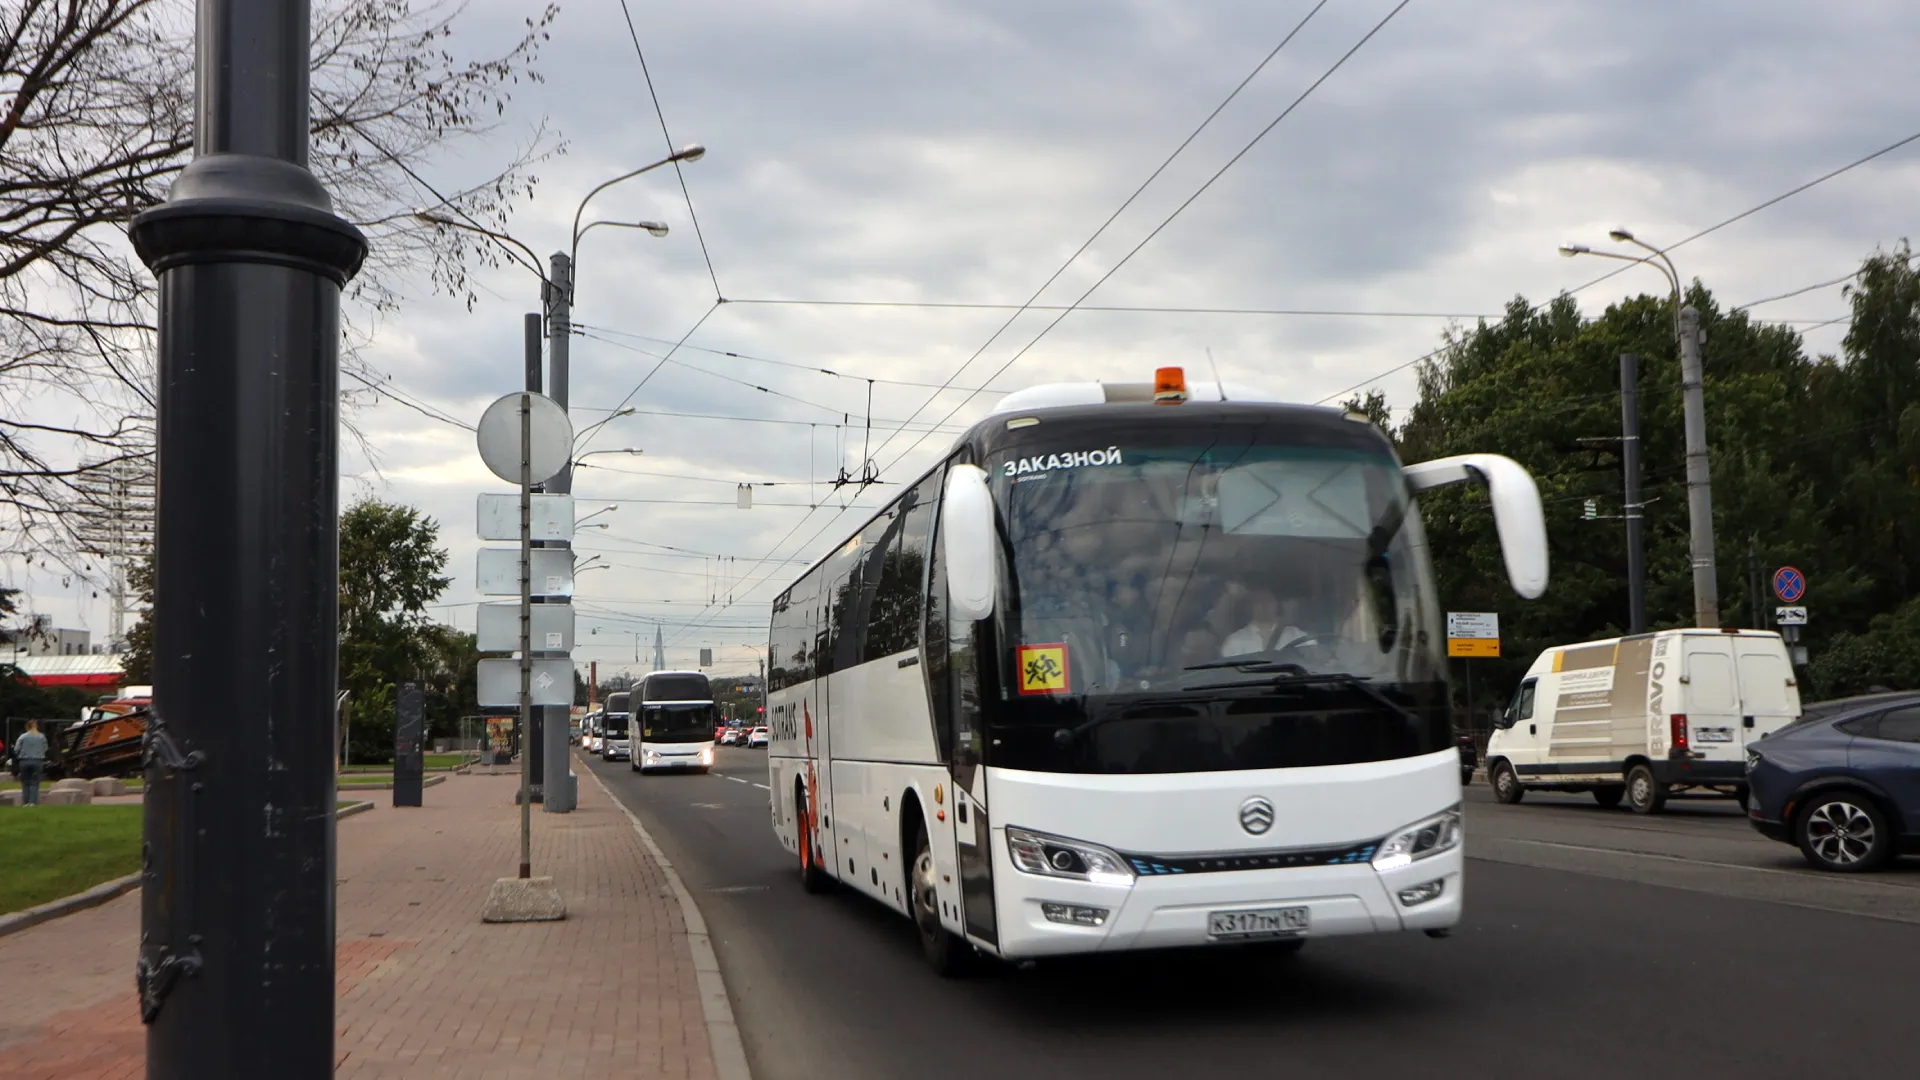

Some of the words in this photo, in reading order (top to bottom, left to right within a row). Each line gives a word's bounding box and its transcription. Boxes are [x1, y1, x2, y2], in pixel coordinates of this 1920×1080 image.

[1003, 445, 1122, 476] ЗАКАЗНОЙ
[771, 702, 797, 742] SOTRANS
[1650, 661, 1665, 756] BRAVO
